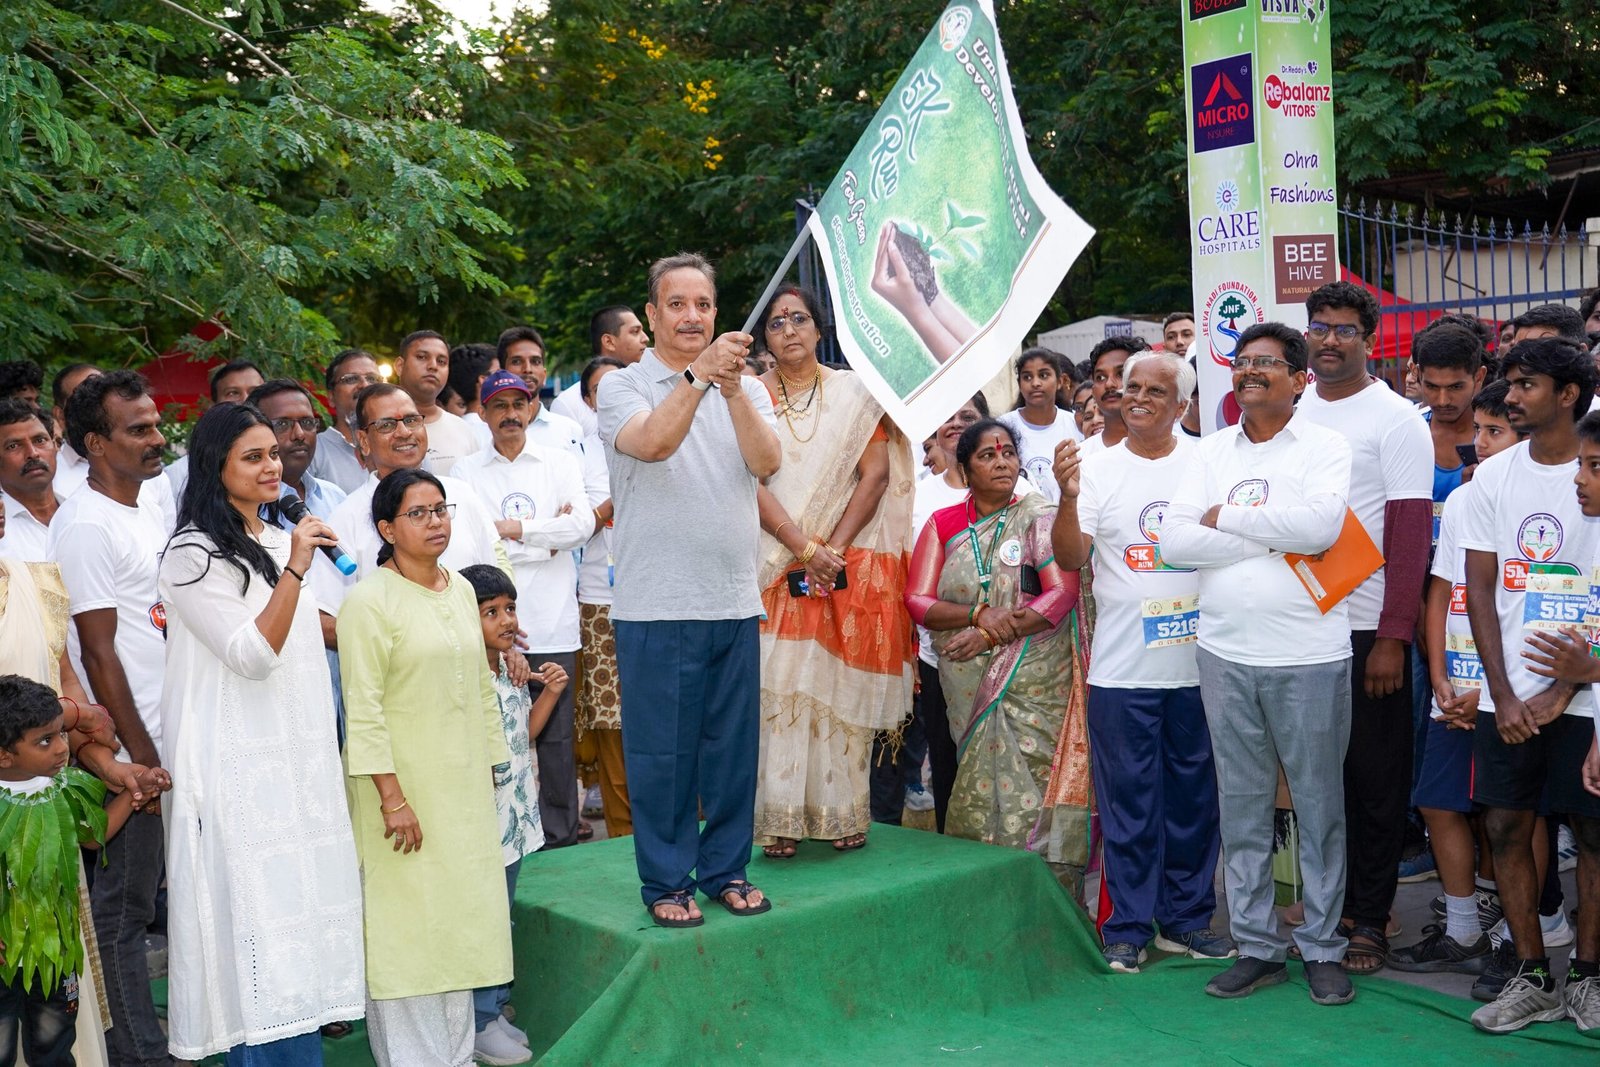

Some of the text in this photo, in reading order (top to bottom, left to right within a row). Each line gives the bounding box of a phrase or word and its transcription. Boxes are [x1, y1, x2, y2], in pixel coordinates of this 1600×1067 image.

[1266, 82, 1330, 101] Rebalanz
[902, 68, 950, 162] 5K
[1198, 102, 1249, 128] MICRO
[1282, 104, 1316, 117] VITORS
[871, 117, 903, 200] Run
[1284, 150, 1319, 168] Ohra
[1270, 182, 1335, 203] Fashions
[841, 170, 867, 245] For Green
[1198, 211, 1259, 242] CARE
[1200, 239, 1260, 255] HOSPITALS
[1285, 243, 1327, 263] BEE
[1289, 265, 1323, 281] HIVE
[832, 216, 890, 356] #GenerationRestoration
[1282, 287, 1312, 295] NATURAL
[1206, 289, 1219, 308] NADI
[1256, 307, 1264, 324] IND
[1223, 304, 1241, 314] JNF
[1129, 549, 1149, 561] 5K
[1514, 579, 1526, 587] RU
[1157, 617, 1199, 637] 5218
